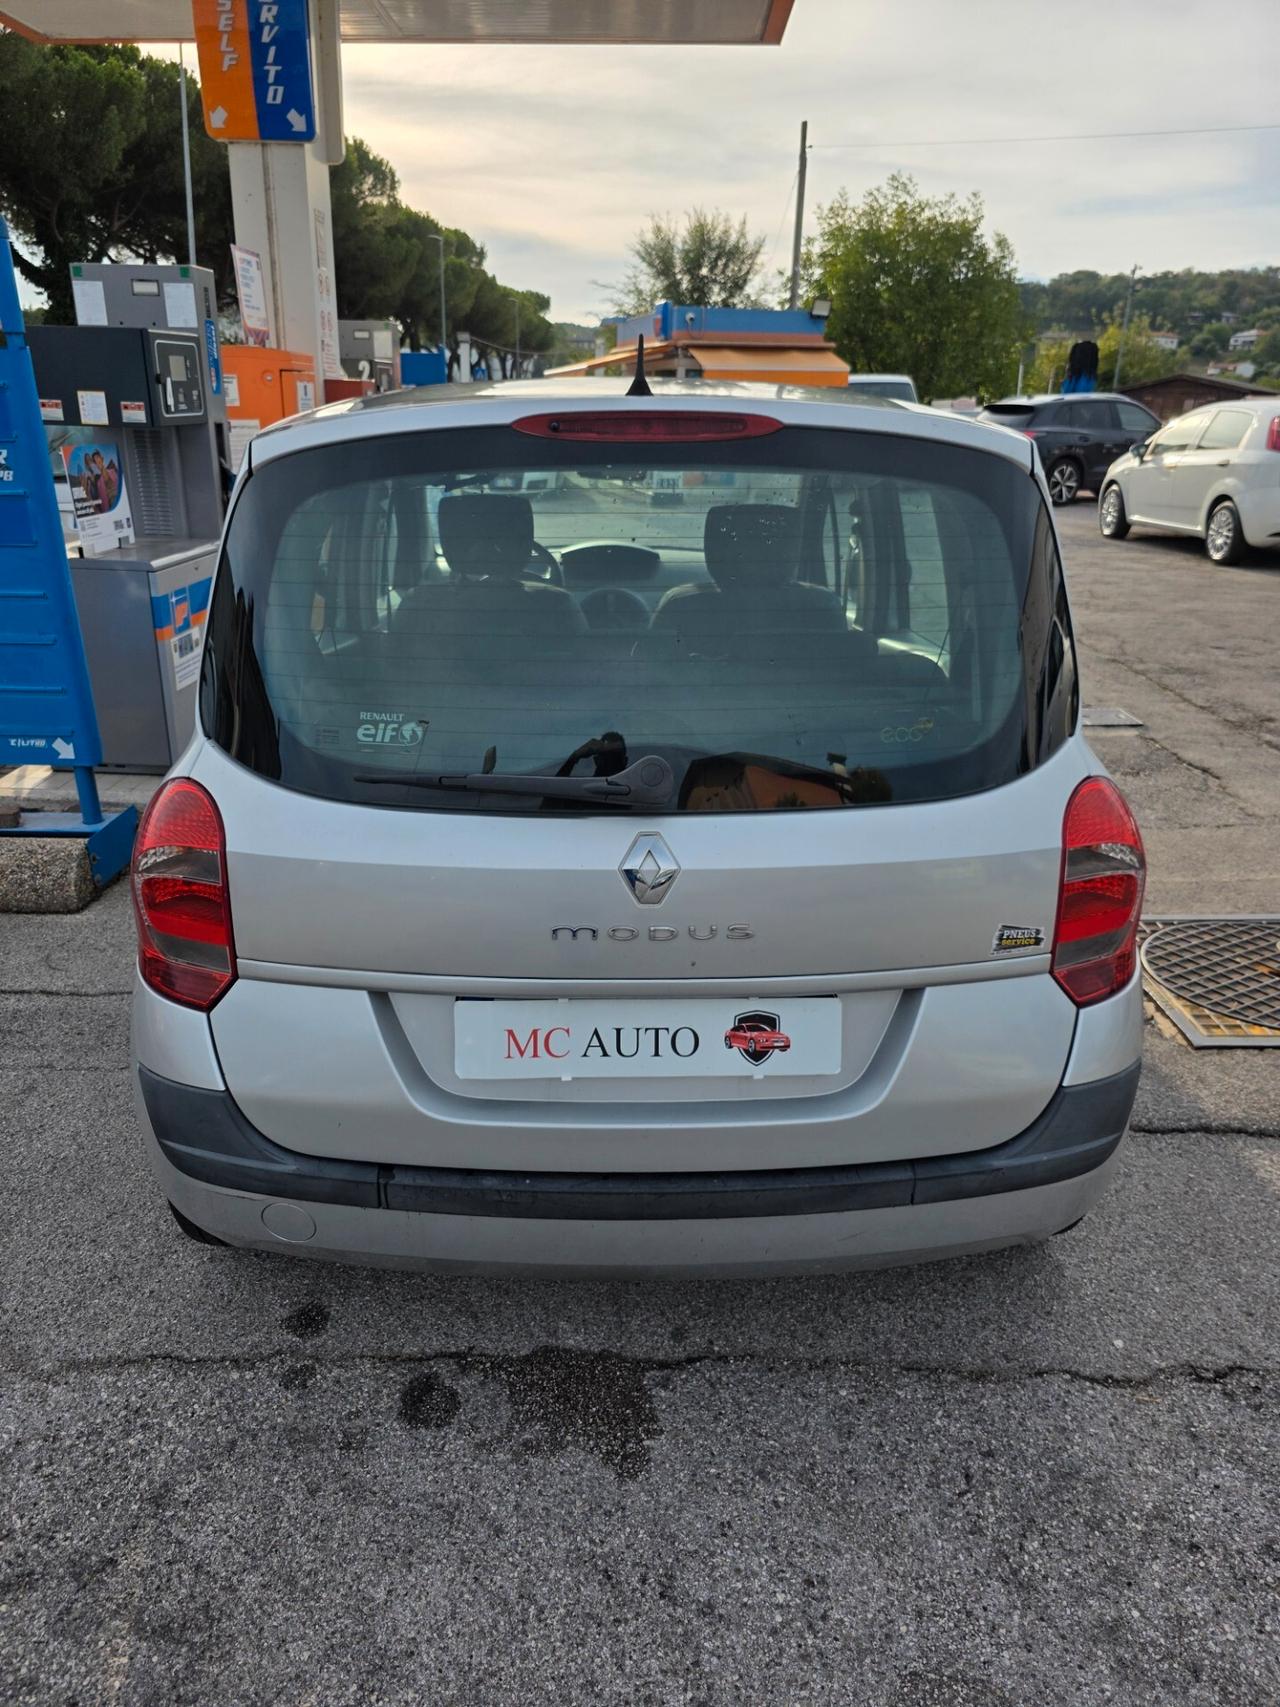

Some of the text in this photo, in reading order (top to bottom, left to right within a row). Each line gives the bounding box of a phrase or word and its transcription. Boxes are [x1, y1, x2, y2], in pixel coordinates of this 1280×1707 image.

[259, 0, 284, 104] RVITO
[360, 711, 405, 721] RENAULT
[356, 723, 399, 743] elf
[551, 923, 756, 941] MODUS
[1003, 929, 1037, 939] PNEUS
[504, 1026, 700, 1060] MC AUTO
